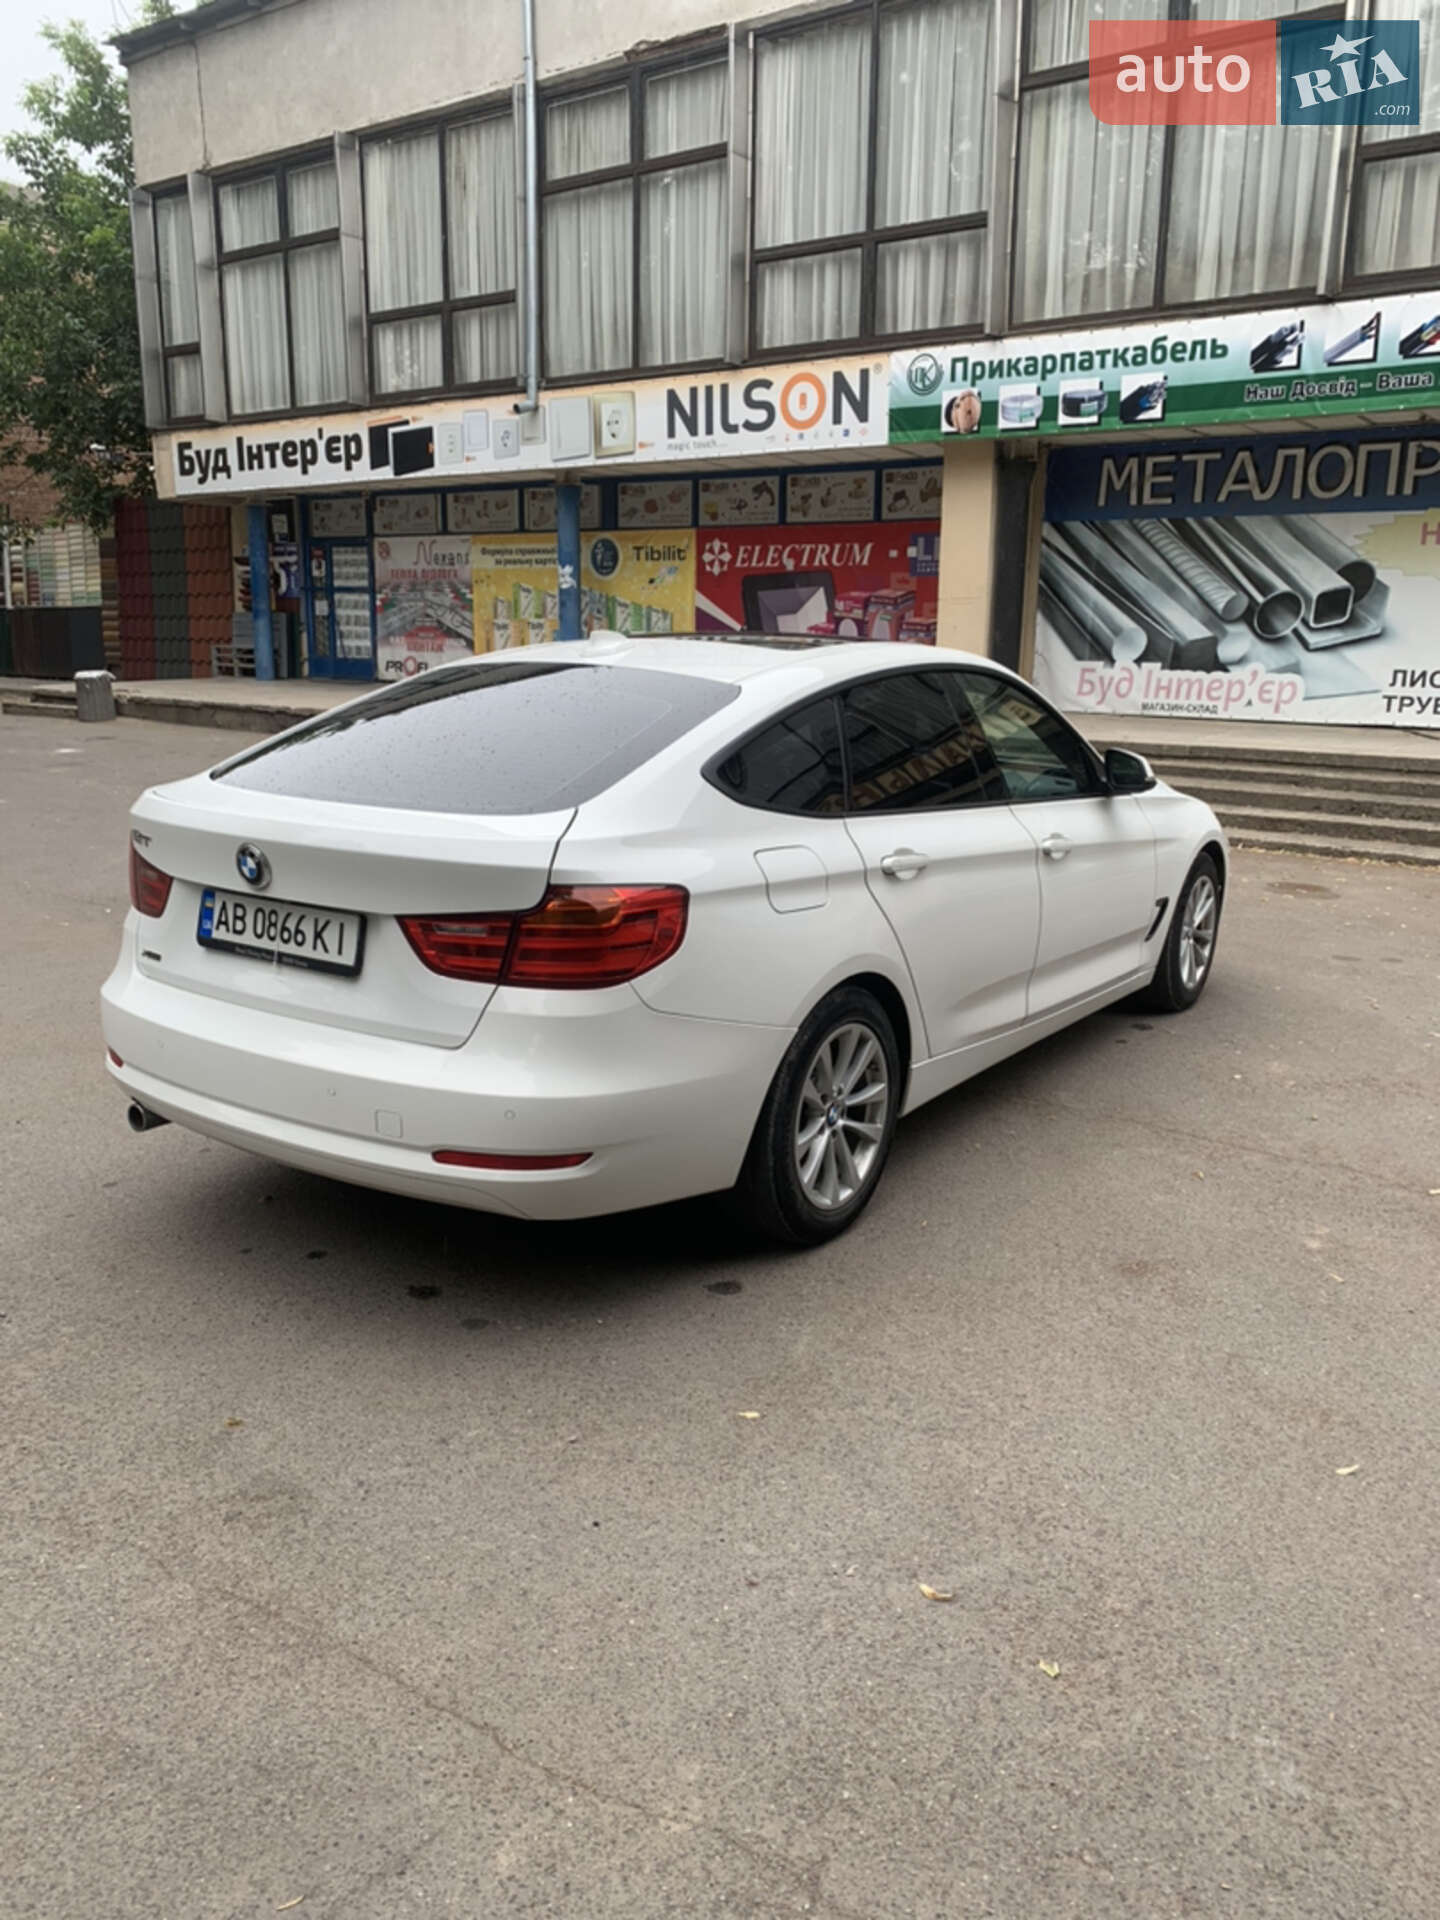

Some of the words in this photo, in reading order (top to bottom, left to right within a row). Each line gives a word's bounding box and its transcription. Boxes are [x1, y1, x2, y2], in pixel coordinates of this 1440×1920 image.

[950, 336, 1229, 385] Прикарпаткабель
[666, 367, 870, 440] NILSON
[1244, 384, 1286, 402] Наш
[1290, 377, 1357, 400] Досвід
[1376, 372, 1435, 391] Ваша
[177, 441, 232, 485] Буд
[236, 427, 363, 475] Інтер'єр
[1097, 440, 1440, 507] МЕТАЛОПР
[413, 540, 470, 566] Nexans
[632, 544, 687, 562] Tibilit
[735, 542, 875, 570] ELECTRUM
[1076, 667, 1135, 706] Буд
[1140, 702, 1219, 715] МАГАЗИН-СКЛАД
[215, 900, 247, 936] AB
[252, 907, 307, 947] 0866
